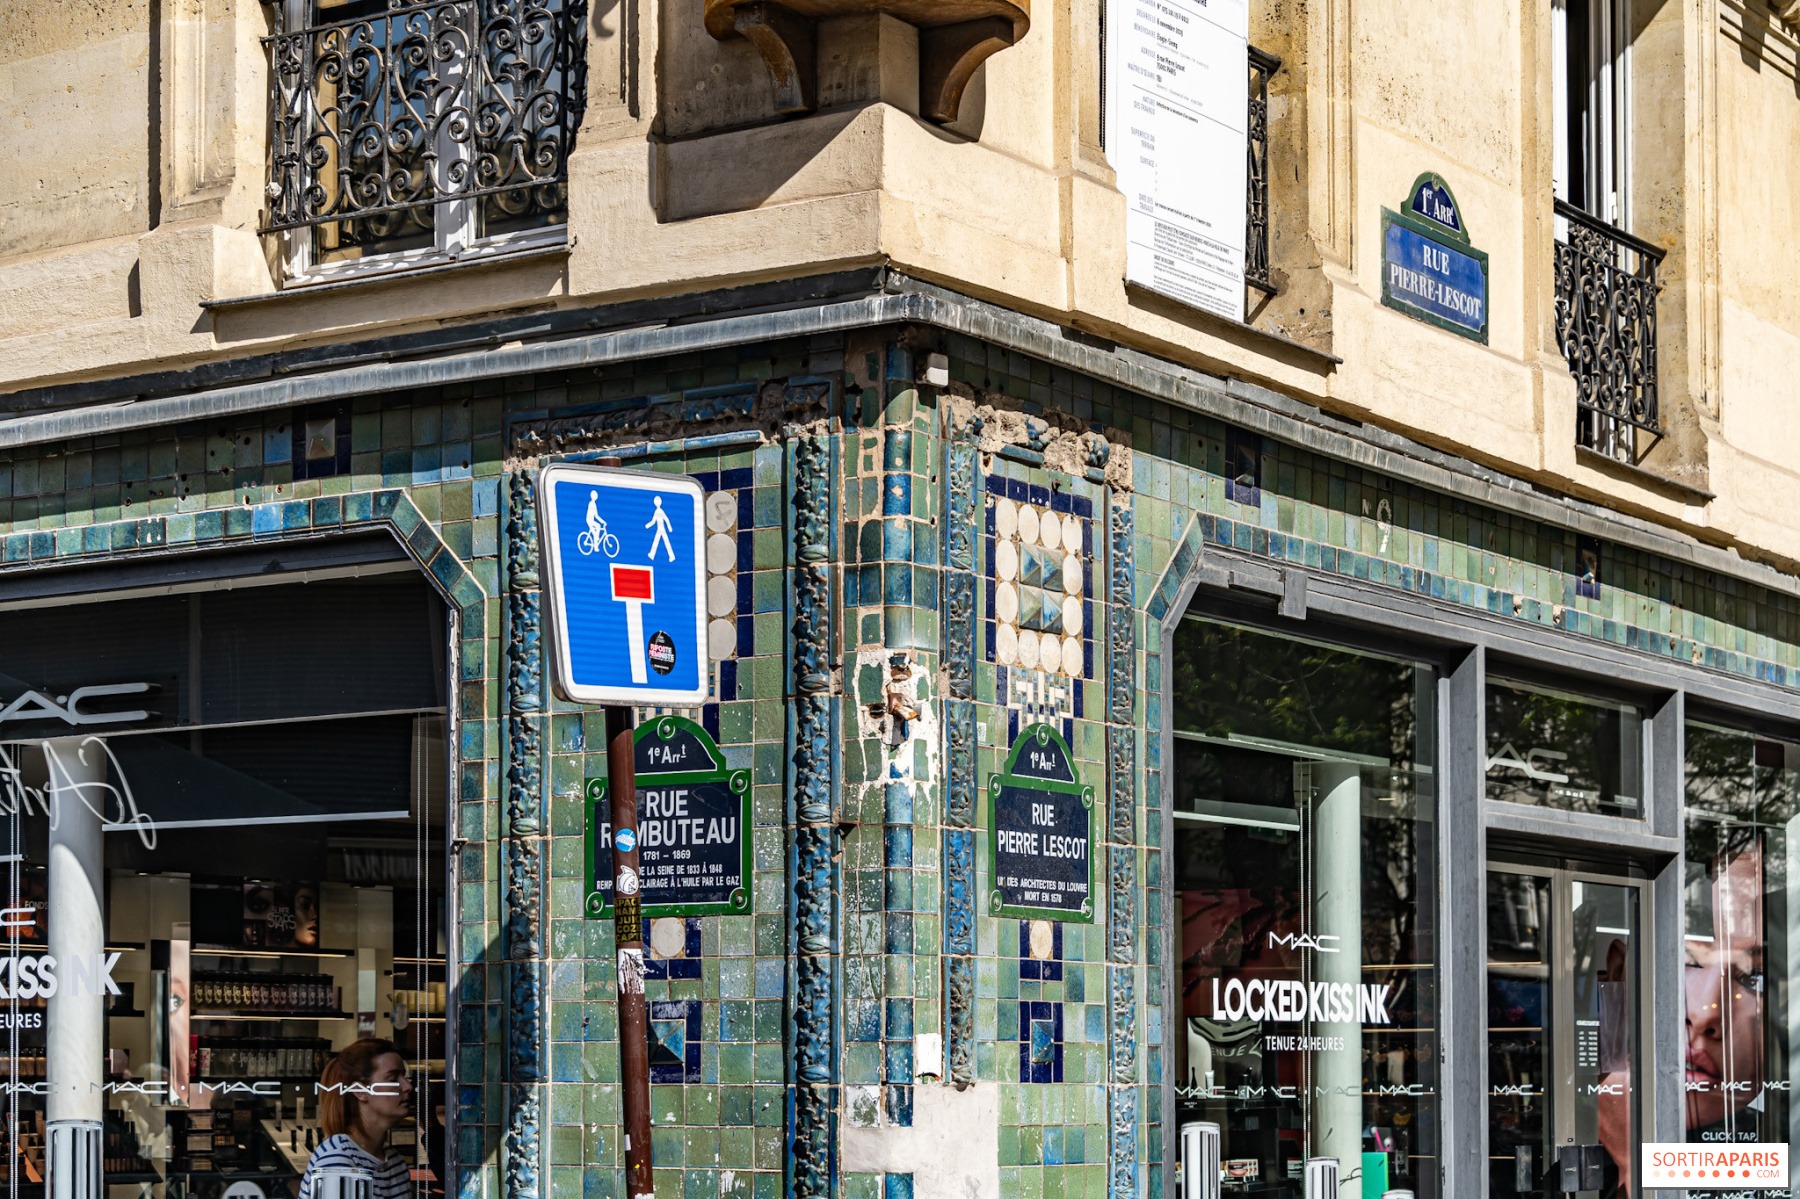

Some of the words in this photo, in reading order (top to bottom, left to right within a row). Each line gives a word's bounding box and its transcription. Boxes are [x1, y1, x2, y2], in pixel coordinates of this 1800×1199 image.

[1423, 244, 1449, 276] RUE
[1390, 263, 1481, 320] PIERRE-LESCOT
[0, 682, 148, 726] AC
[1485, 742, 1569, 784] AC
[646, 790, 688, 818] RUE
[1031, 803, 1055, 827] RUE
[601, 817, 735, 849] RMBUTEAU
[997, 829, 1039, 856] PIERRE
[1043, 834, 1087, 860] LESCOT
[643, 850, 660, 861] 1781
[672, 849, 691, 860] 1869
[646, 866, 655, 876] LA
[657, 865, 675, 876] SEINE
[676, 865, 685, 875] DE
[686, 864, 700, 875] 1833
[709, 863, 723, 874] 1848
[677, 876, 700, 887] L'HUILE
[702, 876, 714, 887] PAR
[716, 876, 724, 886] LE
[726, 875, 740, 886] GAZ
[1007, 876, 1019, 887] DES
[1020, 877, 1057, 890] ARCHITECTES
[1058, 880, 1066, 891] DU
[1067, 882, 1087, 893] LOUVRE
[1024, 890, 1040, 901] MORT
[1042, 892, 1049, 902] EN
[63, 952, 122, 997] INK
[1212, 977, 1308, 1022] LOCKED
[1310, 981, 1354, 1024] KISS
[1356, 983, 1391, 1024] INK
[0, 1013, 42, 1029] EURES
[1265, 1035, 1295, 1051] TENUE
[1297, 1036, 1309, 1051] 24
[1310, 1036, 1344, 1051] HEURES
